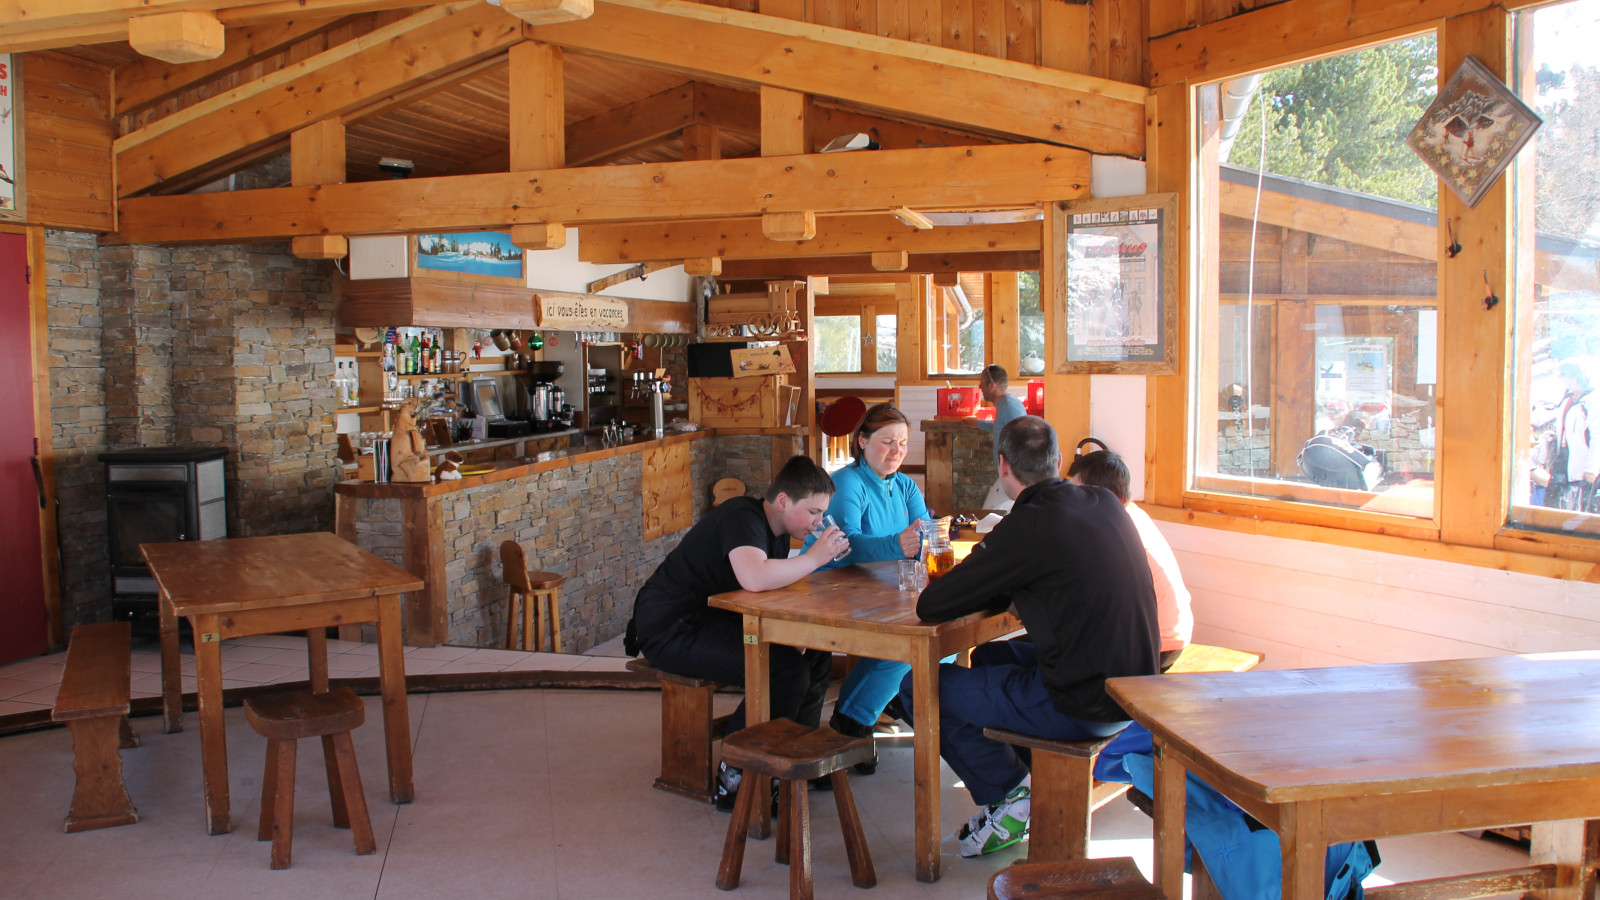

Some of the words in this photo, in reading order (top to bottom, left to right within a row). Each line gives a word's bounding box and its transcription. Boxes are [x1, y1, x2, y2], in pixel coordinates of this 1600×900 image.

[546, 302, 556, 317] ici
[557, 306, 573, 317] vous
[574, 301, 588, 317] êtes
[590, 307, 598, 318] en
[599, 308, 623, 319] vacances
[205, 634, 213, 643] 7
